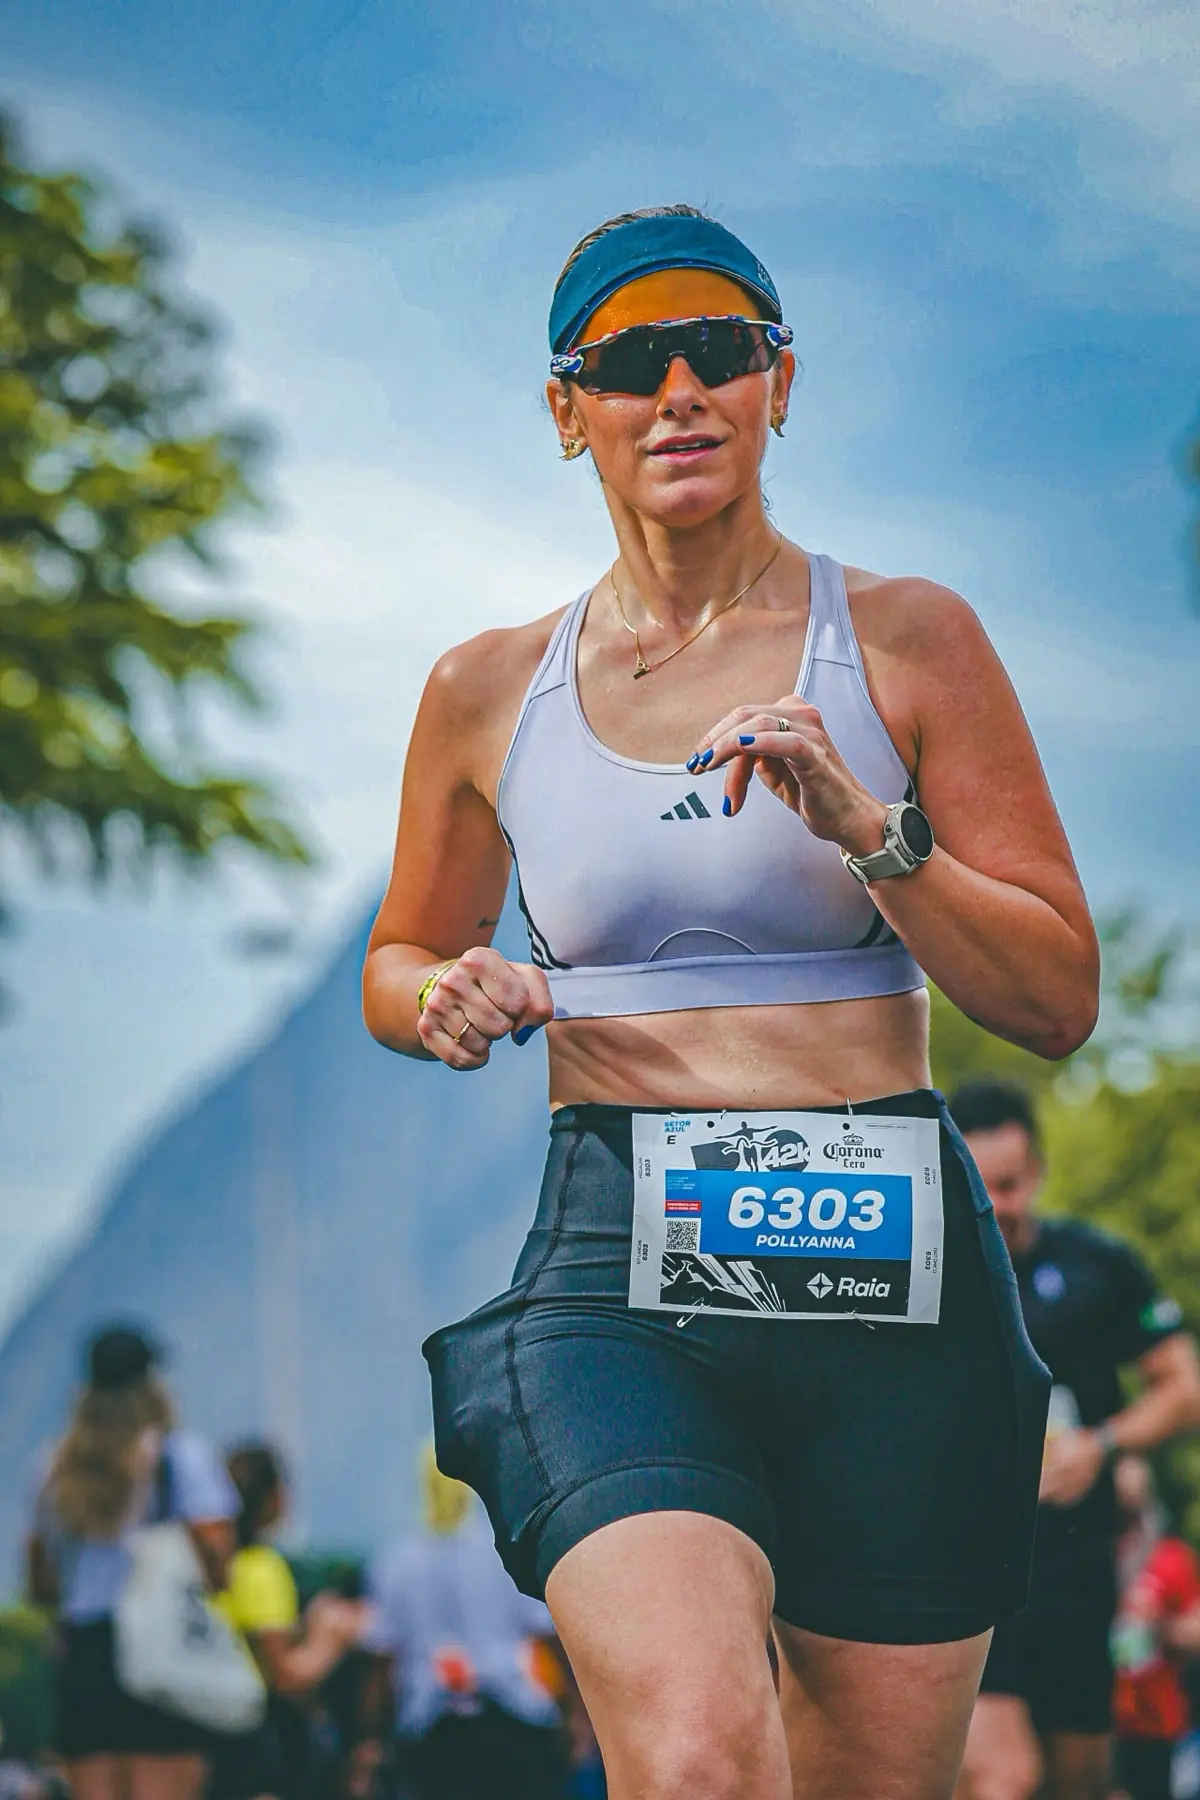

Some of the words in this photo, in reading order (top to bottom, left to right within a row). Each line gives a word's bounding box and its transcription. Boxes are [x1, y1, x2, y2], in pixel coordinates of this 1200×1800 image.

[667, 1135, 677, 1145] E
[823, 1142, 884, 1162] Corona
[843, 1159, 865, 1169] Cero
[728, 1186, 886, 1232] 6303
[755, 1234, 856, 1250] POLLYANNA
[924, 1250, 932, 1270] 6303
[837, 1277, 891, 1298] Raia
